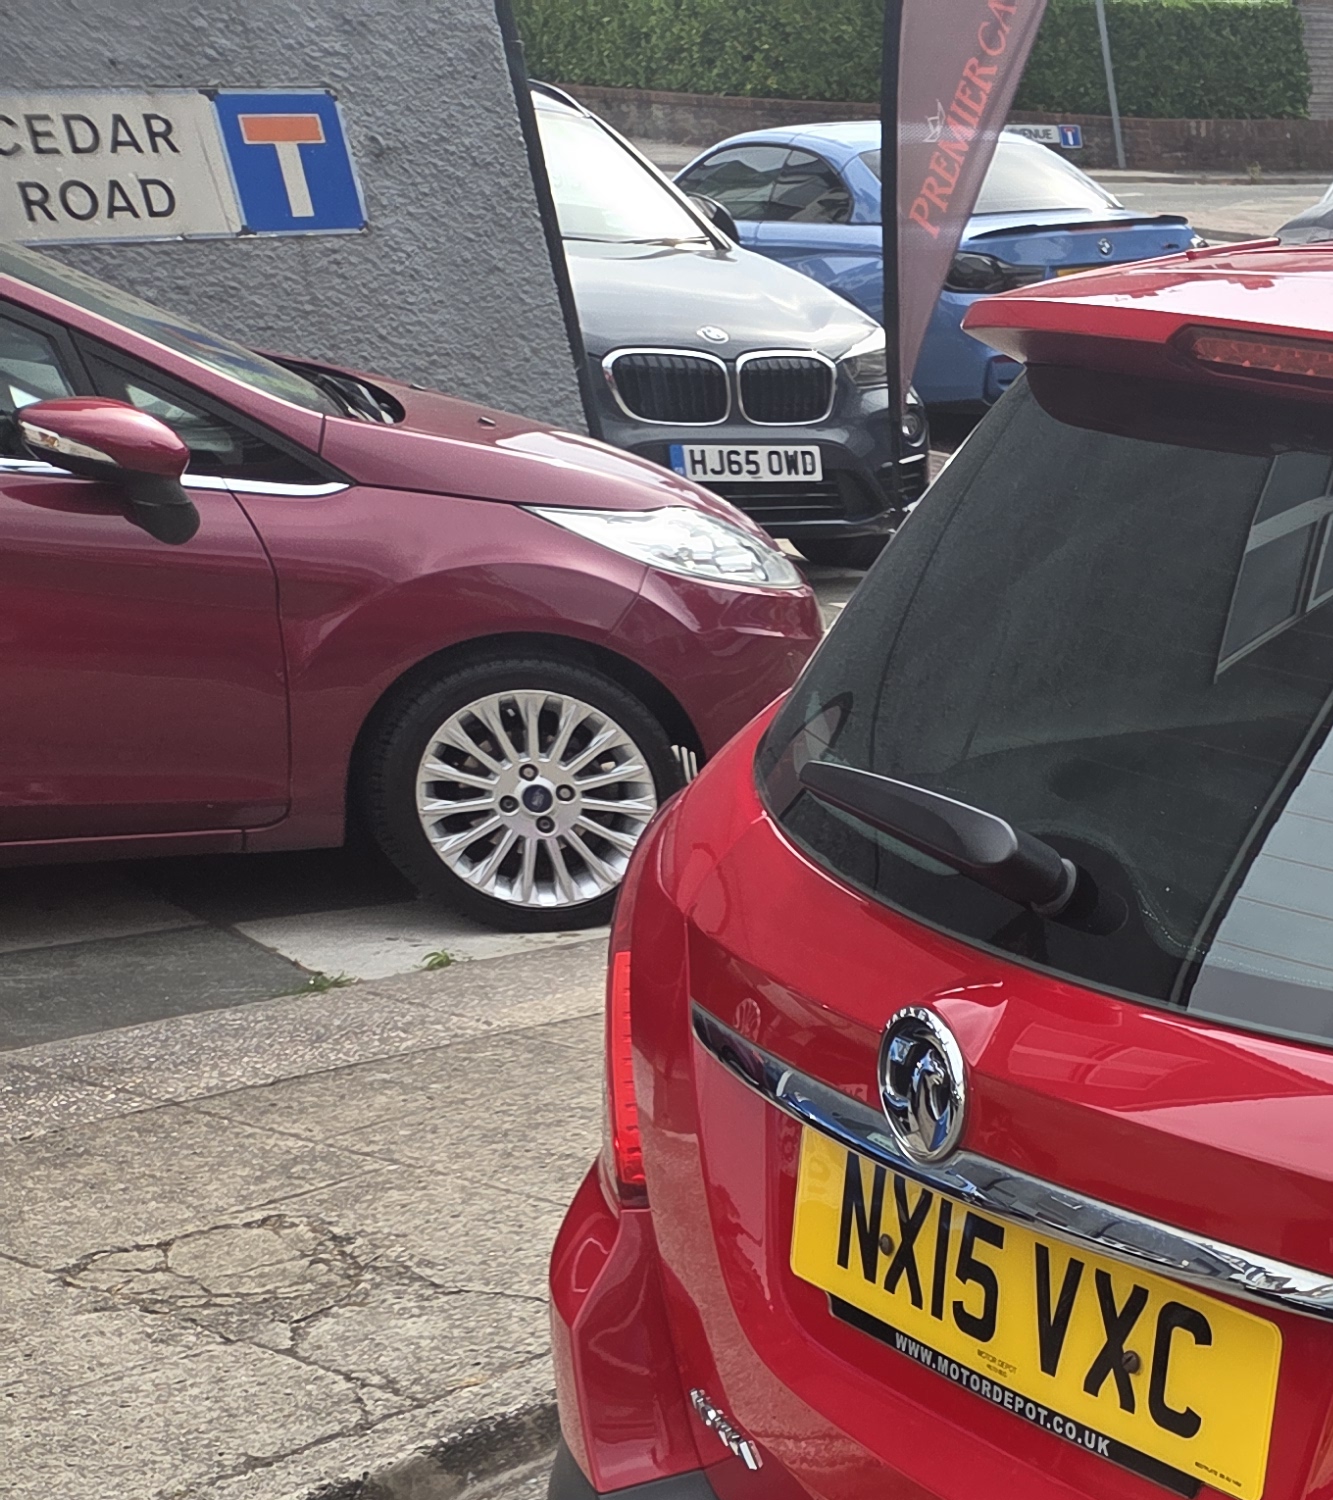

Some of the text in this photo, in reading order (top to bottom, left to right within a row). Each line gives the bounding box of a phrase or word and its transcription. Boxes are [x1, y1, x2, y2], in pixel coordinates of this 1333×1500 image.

[17, 178, 177, 222] ROAD
[908, 57, 998, 240] PREMIER
[688, 449, 817, 476] HJ65 OWD
[837, 1150, 1213, 1439] NX15 VXC
[895, 1332, 1111, 1457] WWW.MOTORDEPOT.CO.UK
